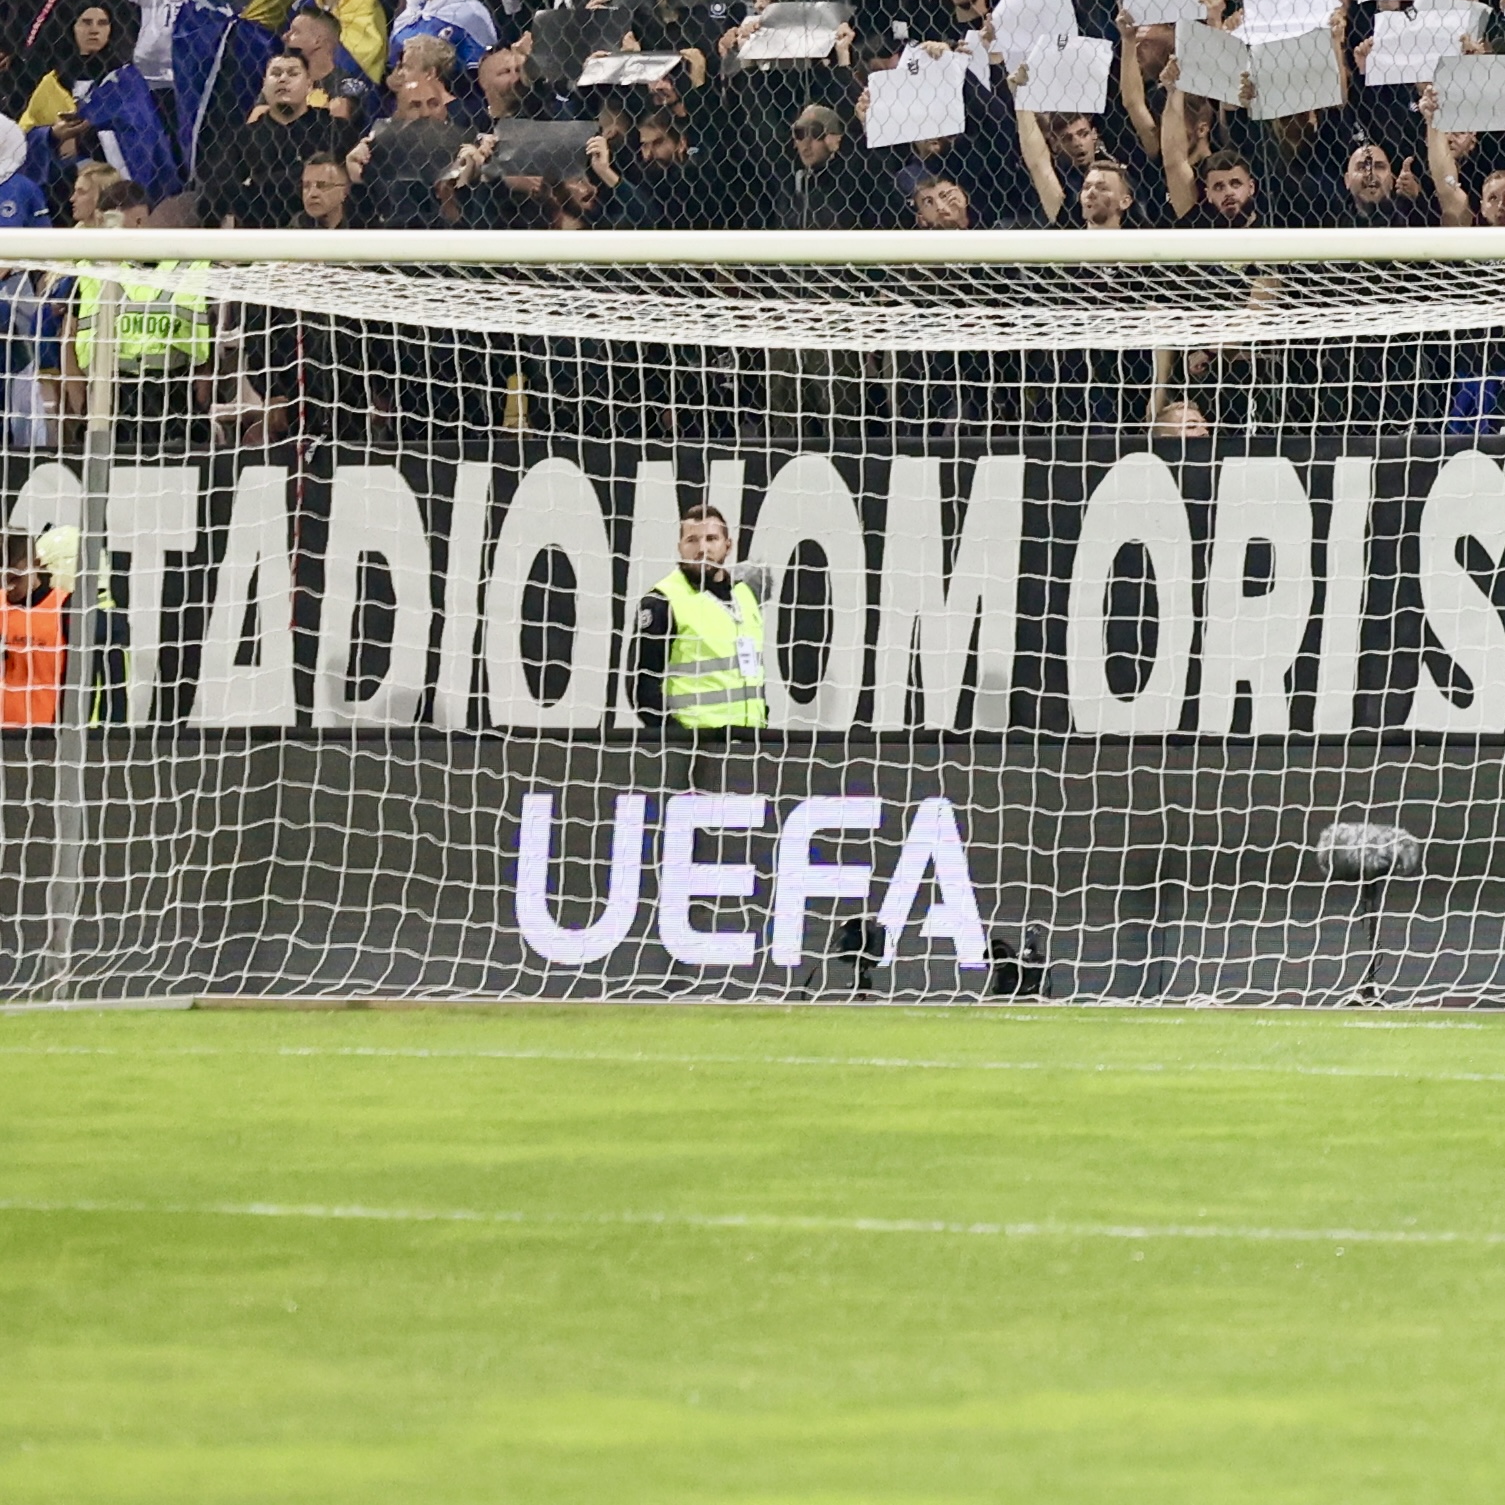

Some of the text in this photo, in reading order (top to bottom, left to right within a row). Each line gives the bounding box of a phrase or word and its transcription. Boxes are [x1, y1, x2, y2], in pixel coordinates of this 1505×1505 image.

[120, 315, 182, 336] ONDOR
[1068, 451, 1375, 734] ORI
[514, 792, 988, 969] UEFA
